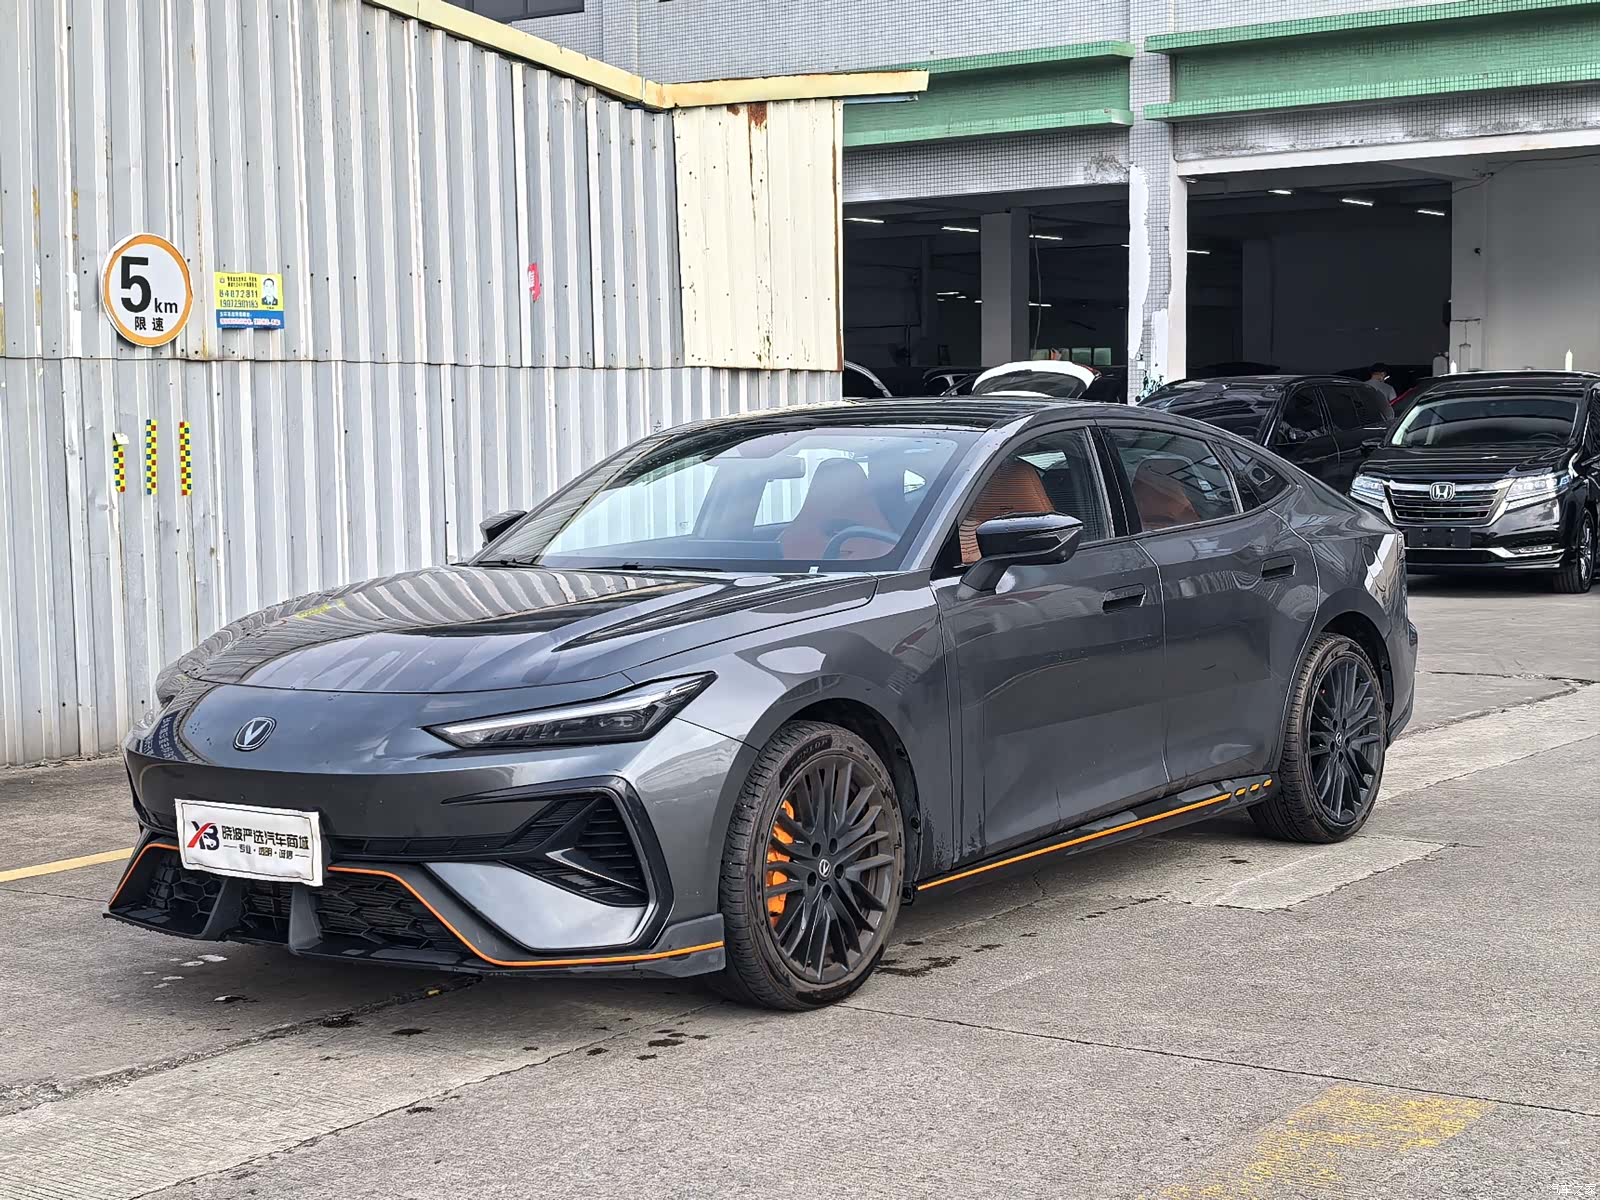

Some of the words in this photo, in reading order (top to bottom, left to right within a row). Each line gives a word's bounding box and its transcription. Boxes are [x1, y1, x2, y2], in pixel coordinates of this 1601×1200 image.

[120, 256, 151, 313] 5
[154, 298, 177, 313] km
[135, 316, 164, 331] 限速
[221, 825, 310, 850] 晓波严选汽车商城
